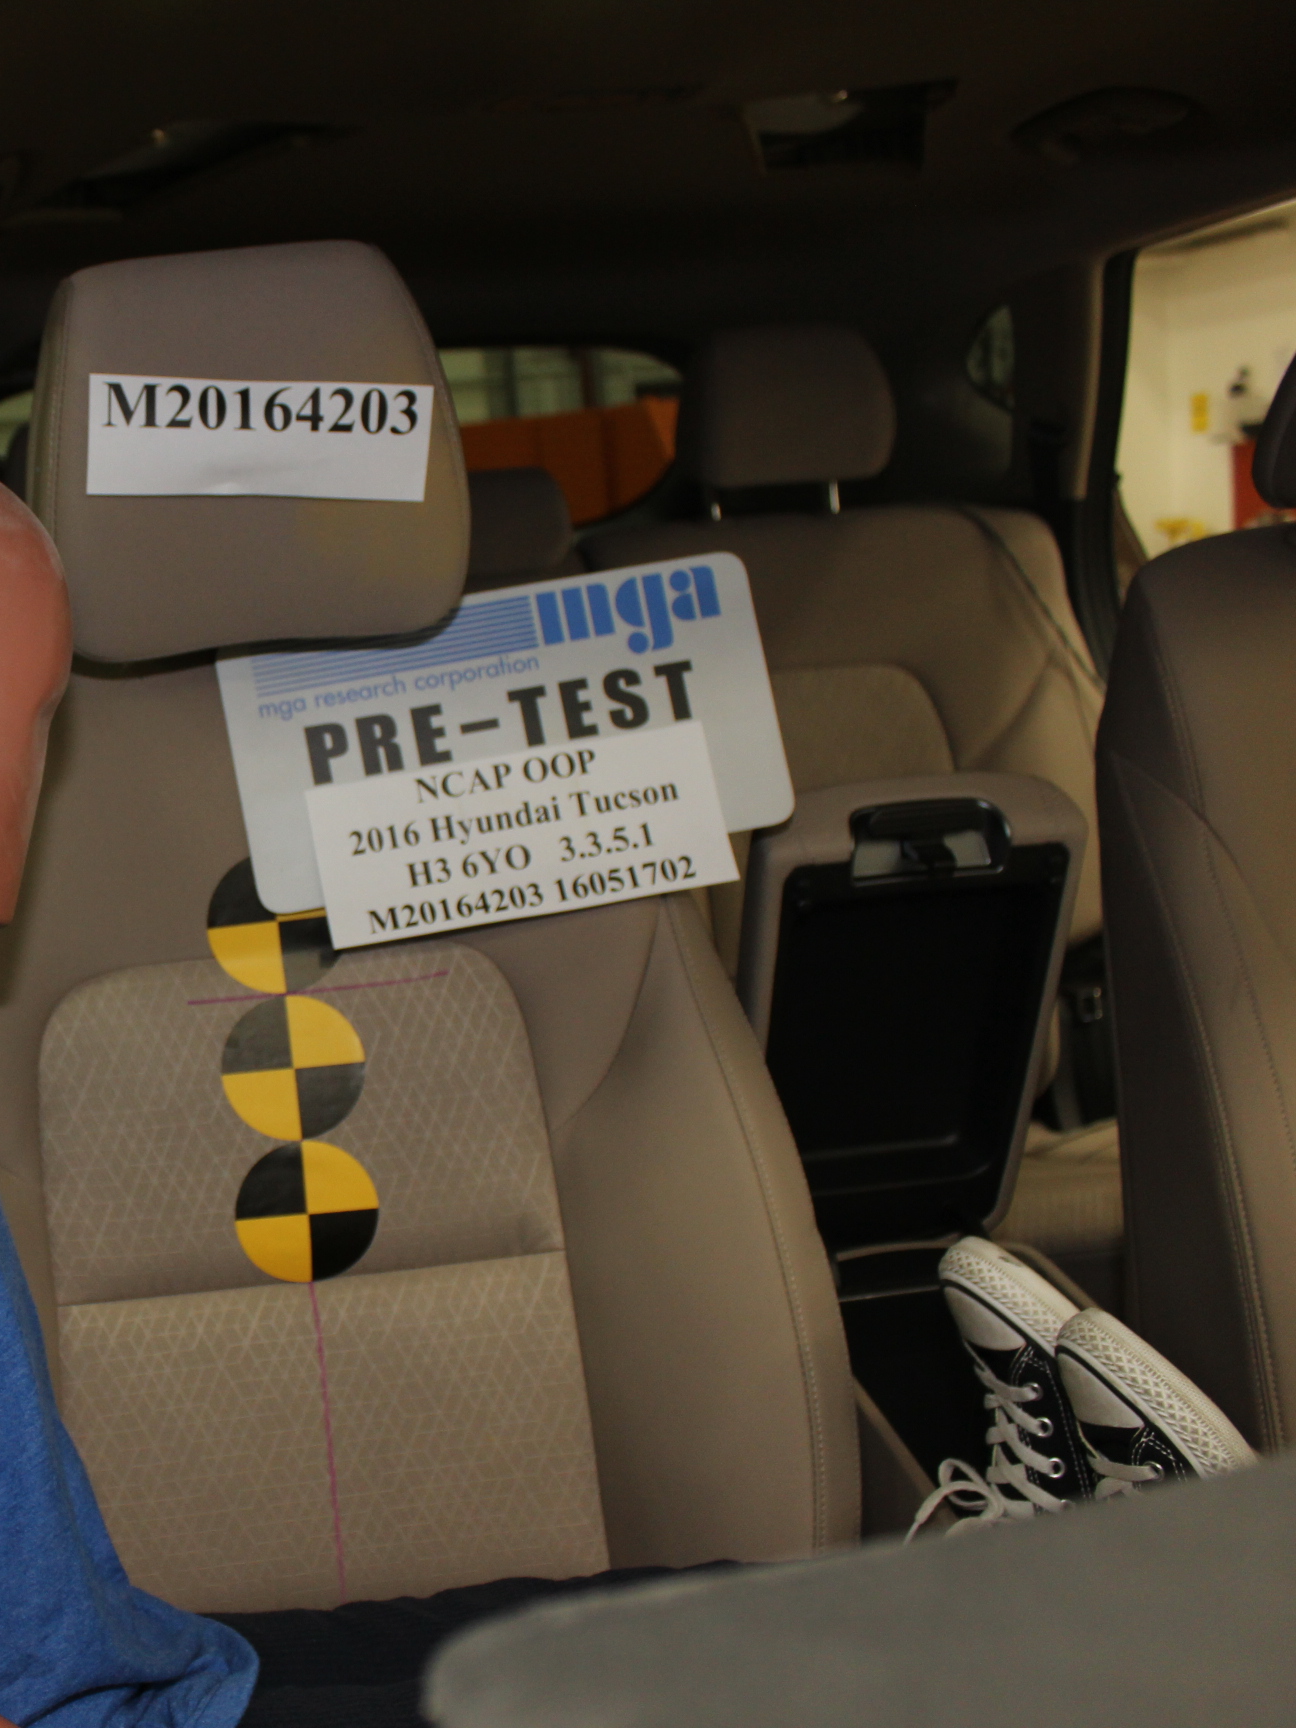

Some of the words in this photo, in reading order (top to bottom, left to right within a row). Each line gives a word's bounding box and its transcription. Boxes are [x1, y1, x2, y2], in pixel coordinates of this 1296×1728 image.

[102, 381, 419, 436] M20164203
[536, 565, 722, 654] mga
[258, 696, 307, 721] mga
[314, 673, 407, 708] research
[413, 654, 541, 693] corporation
[305, 659, 694, 785] PRE-TEST
[413, 762, 512, 804] NCAP
[522, 748, 596, 783] OOP
[349, 823, 421, 856] 2016
[431, 797, 562, 845] Hyundai
[569, 782, 680, 819] Tucson
[407, 856, 453, 889] H3
[463, 842, 531, 879] 6YO
[560, 820, 656, 862] 3.3.5.1
[368, 882, 546, 935] M20164203
[555, 854, 698, 903] 16051702
